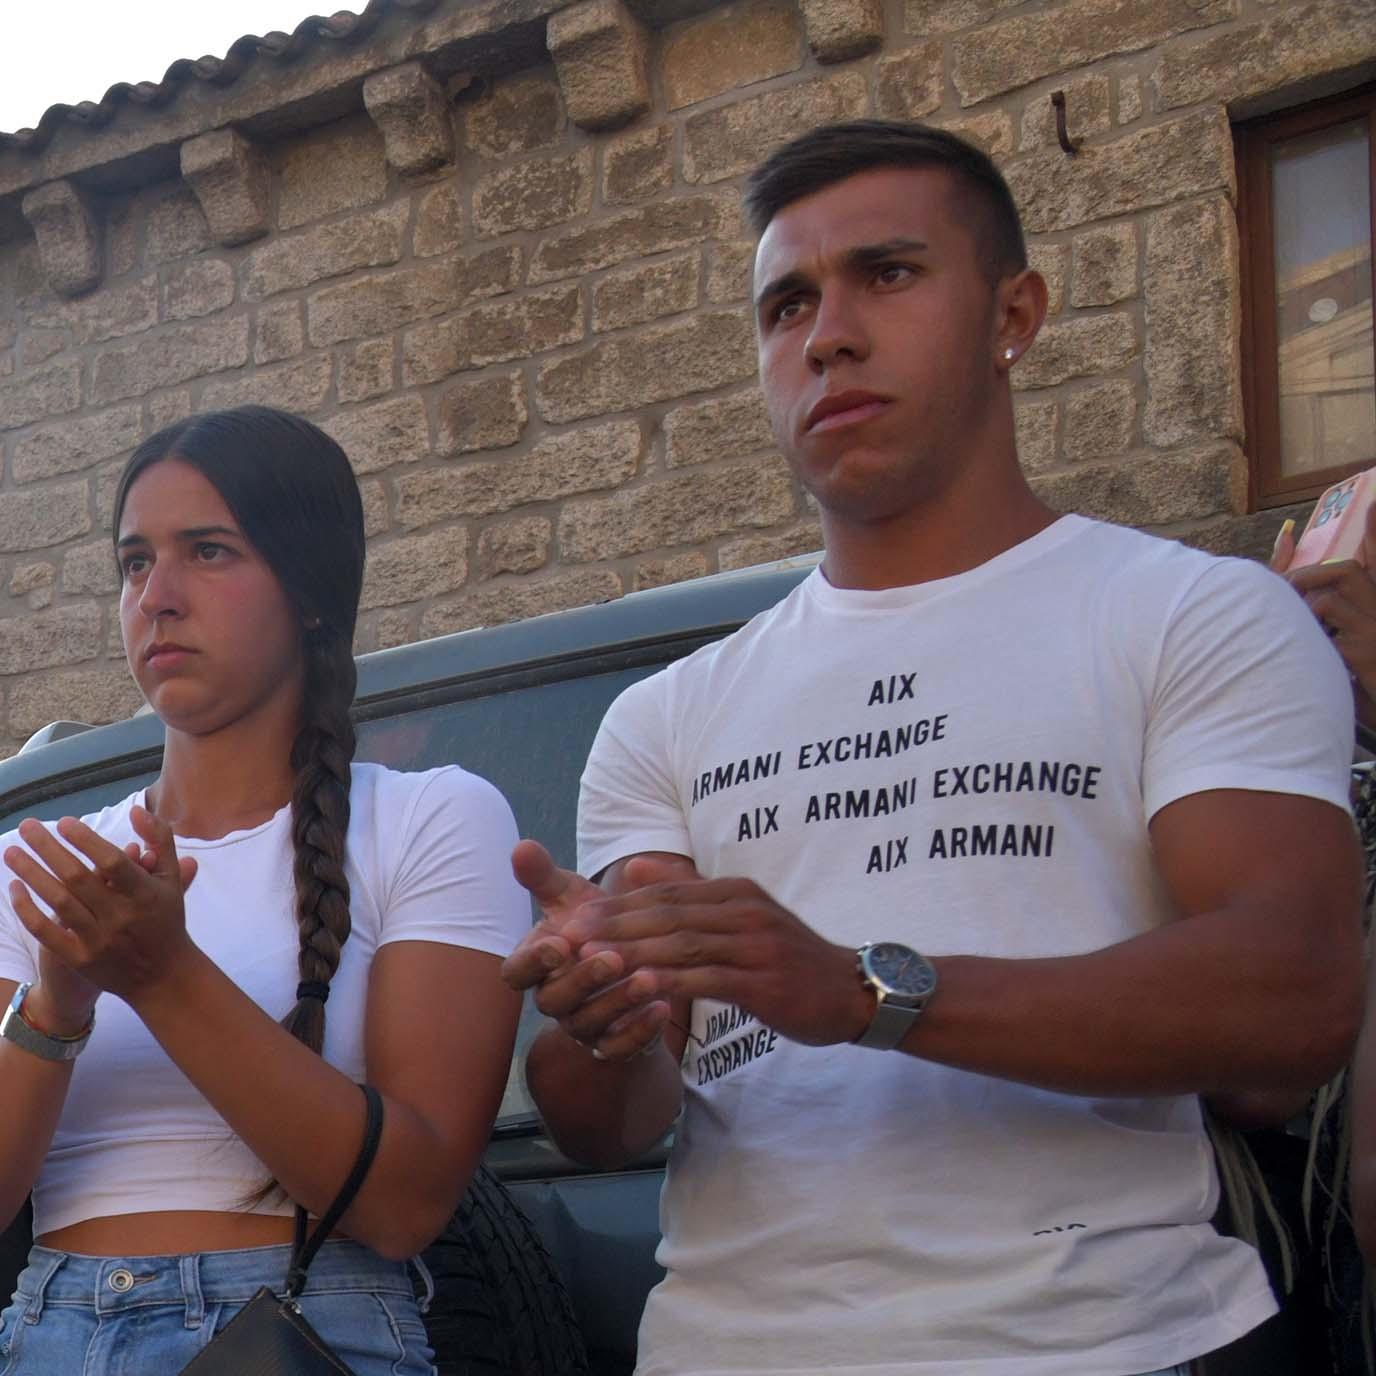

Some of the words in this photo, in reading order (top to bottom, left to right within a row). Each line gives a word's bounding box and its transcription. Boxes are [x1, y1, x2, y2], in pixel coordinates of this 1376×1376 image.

[692, 751, 782, 808] ARMANI
[797, 714, 949, 770] EXCHANGE
[804, 777, 917, 824] ARMANI
[932, 761, 1102, 800] EXCHANGE
[928, 824, 1055, 859] ARMANI
[697, 1028, 778, 1087] EXCHANGE
